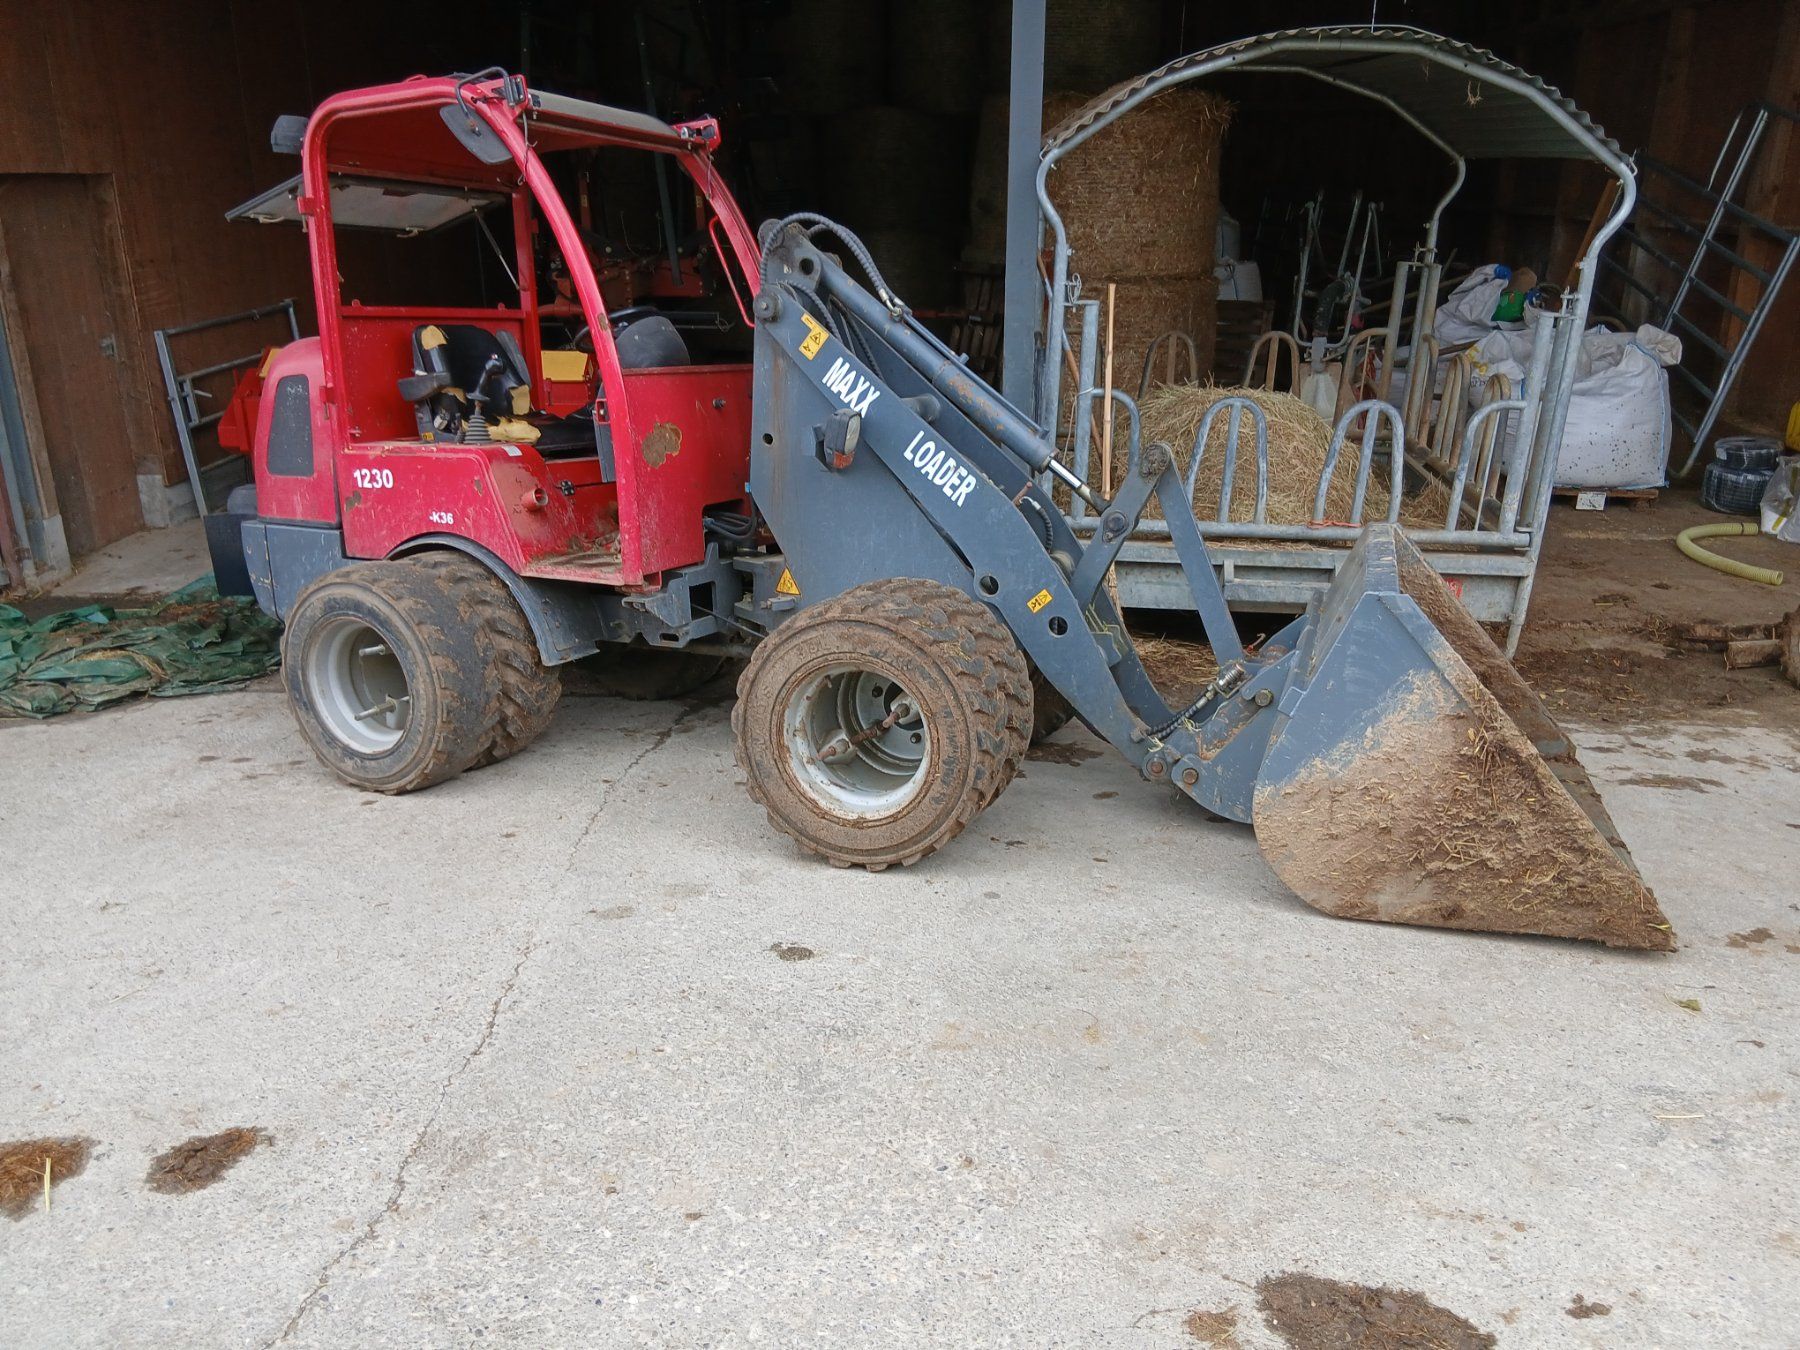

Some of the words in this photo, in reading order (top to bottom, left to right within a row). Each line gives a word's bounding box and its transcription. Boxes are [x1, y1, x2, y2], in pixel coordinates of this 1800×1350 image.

[821, 356, 881, 418] MAXX
[903, 430, 977, 508] LOADER
[353, 468, 394, 489] 1230
